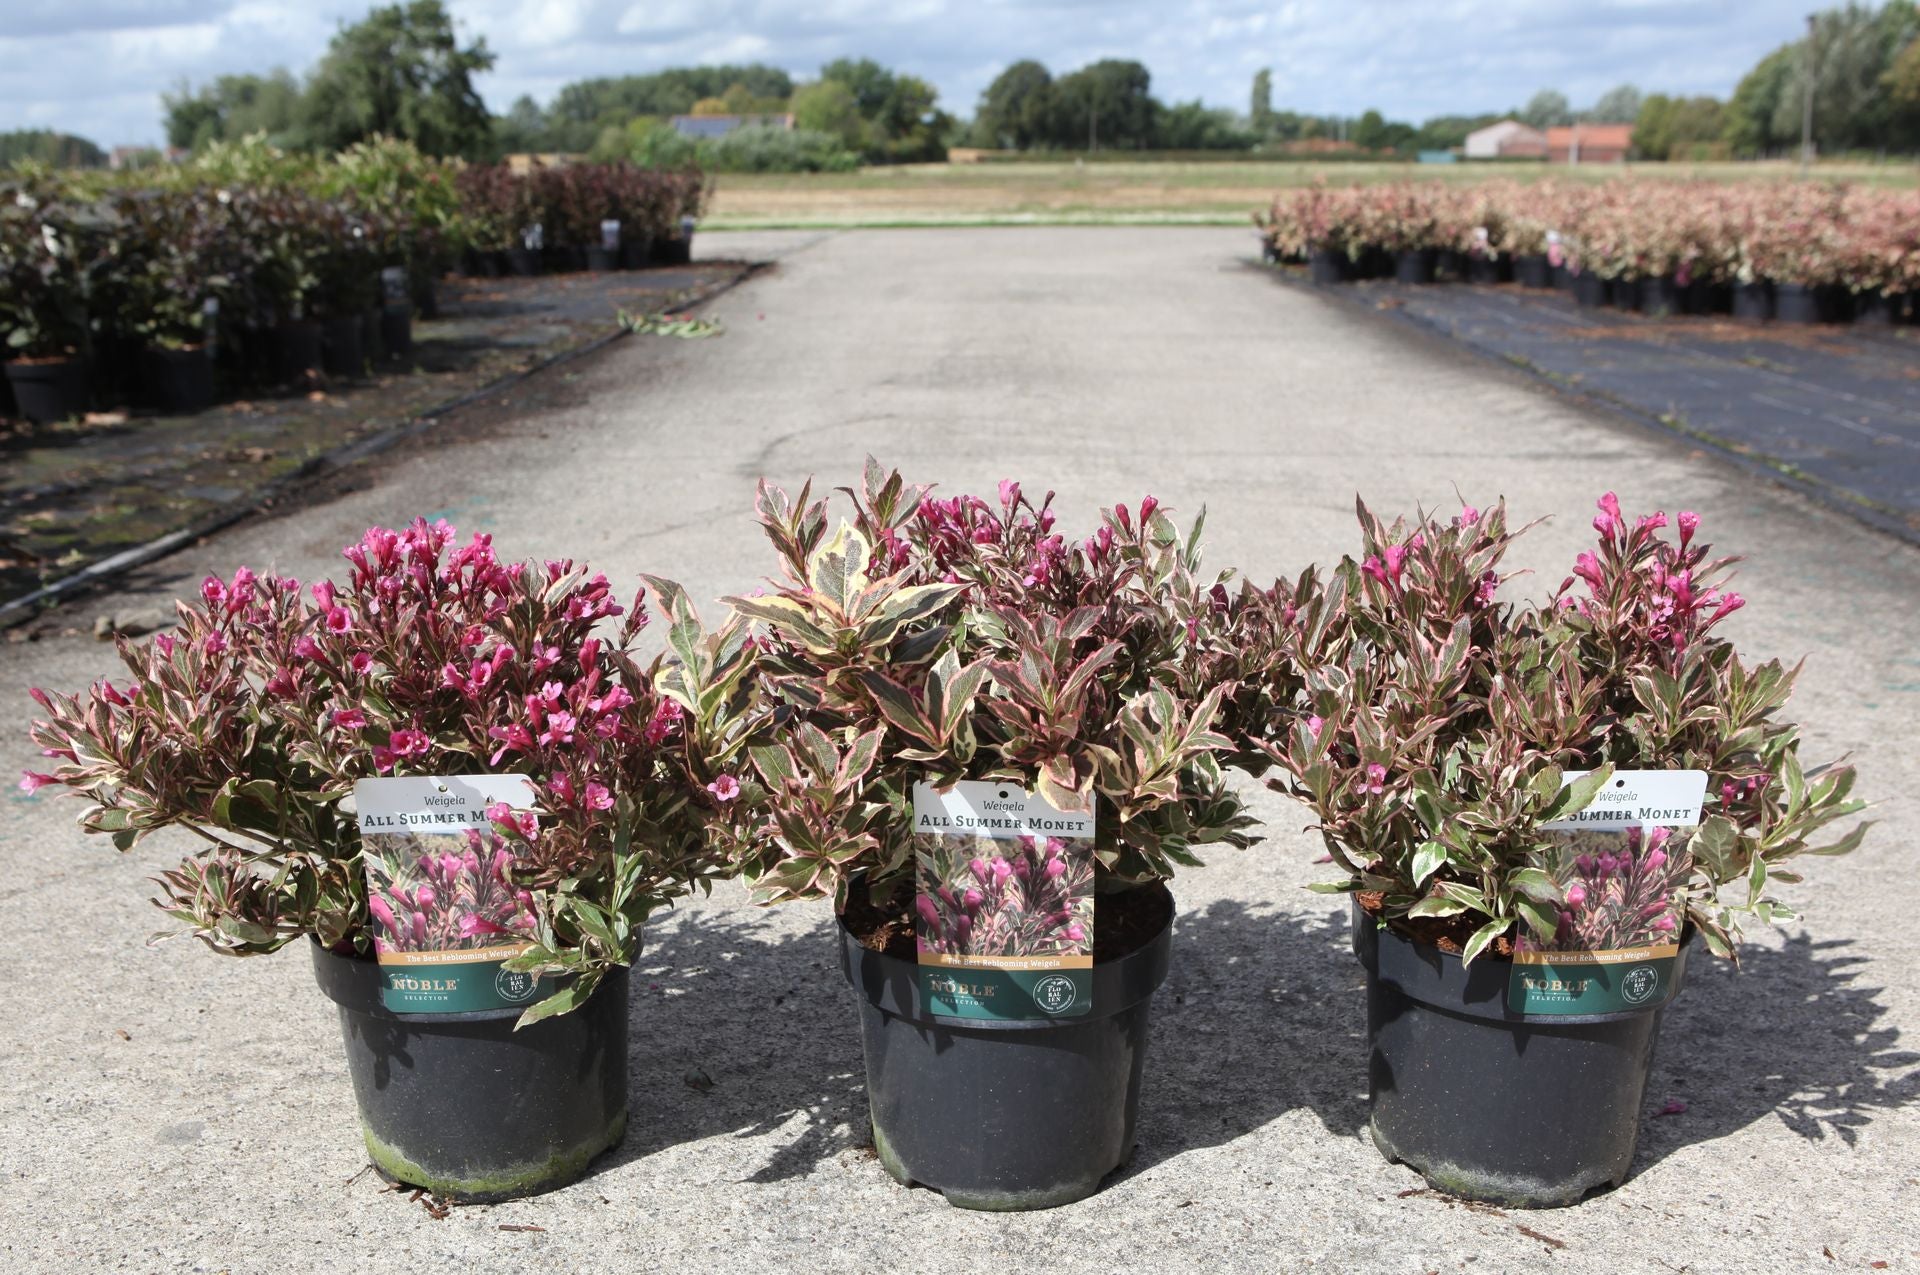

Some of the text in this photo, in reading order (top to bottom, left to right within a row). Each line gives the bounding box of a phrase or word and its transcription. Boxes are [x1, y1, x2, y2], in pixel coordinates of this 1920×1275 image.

[424, 796, 465, 808] Weigela
[1599, 791, 1638, 803] Weigela
[983, 801, 1025, 813] Weigela
[364, 815, 394, 827] ALL
[400, 812, 467, 826] SUMMER
[1638, 808, 1691, 820] MONET
[920, 814, 1085, 831] ALL SUMMER MONET
[406, 949, 519, 963] The Best Reblooming Weigela
[1561, 954, 1577, 962] Best
[1579, 952, 1623, 962] Reblooming
[1624, 951, 1650, 961] Weigela
[947, 957, 1060, 969] The Best Reblooming Weigela
[392, 979, 457, 991] NOBLE
[931, 980, 995, 997] NOBLE
[1521, 978, 1588, 991] NOBLE
